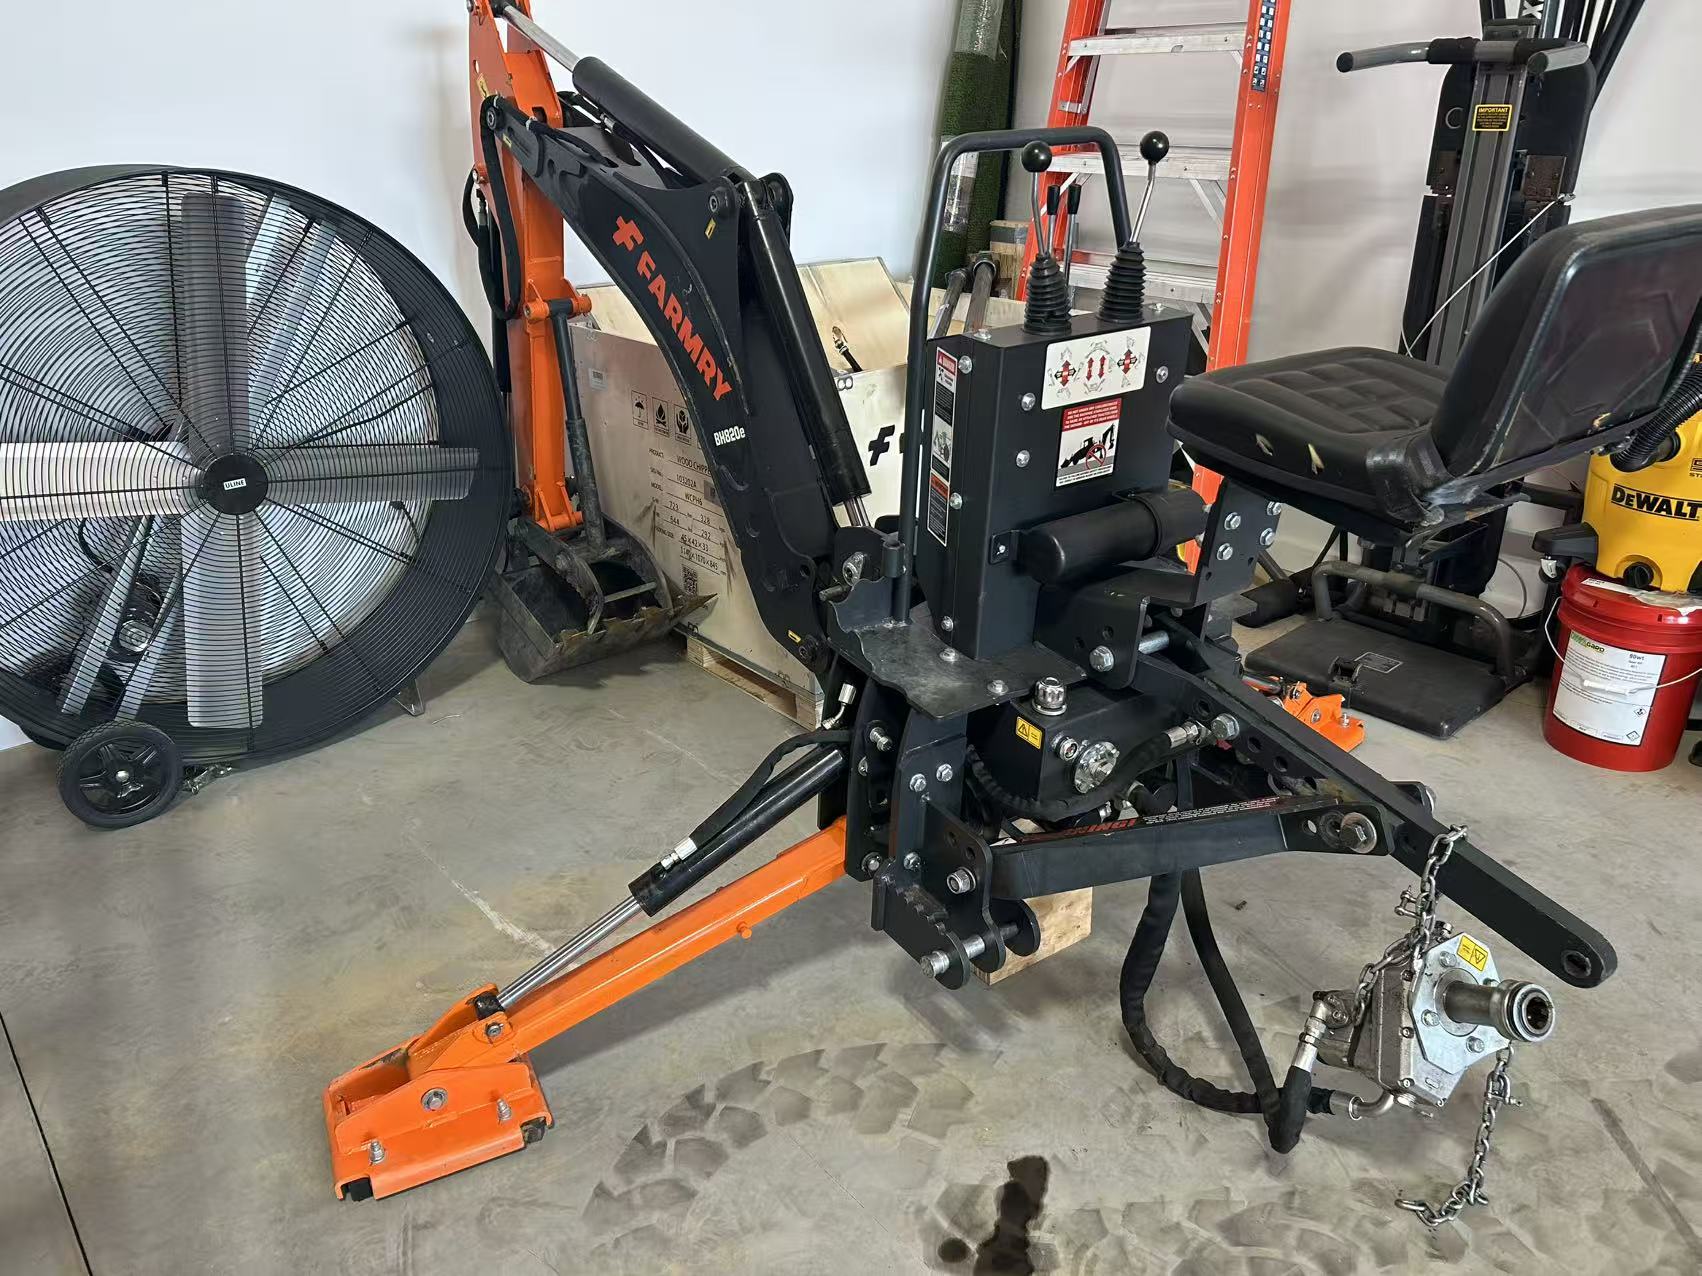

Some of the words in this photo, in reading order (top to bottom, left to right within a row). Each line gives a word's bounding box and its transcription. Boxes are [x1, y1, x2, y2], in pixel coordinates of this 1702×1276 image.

[637, 251, 733, 401] FARMRY
[713, 425, 746, 446] BH820e
[224, 480, 245, 489] ULINE
